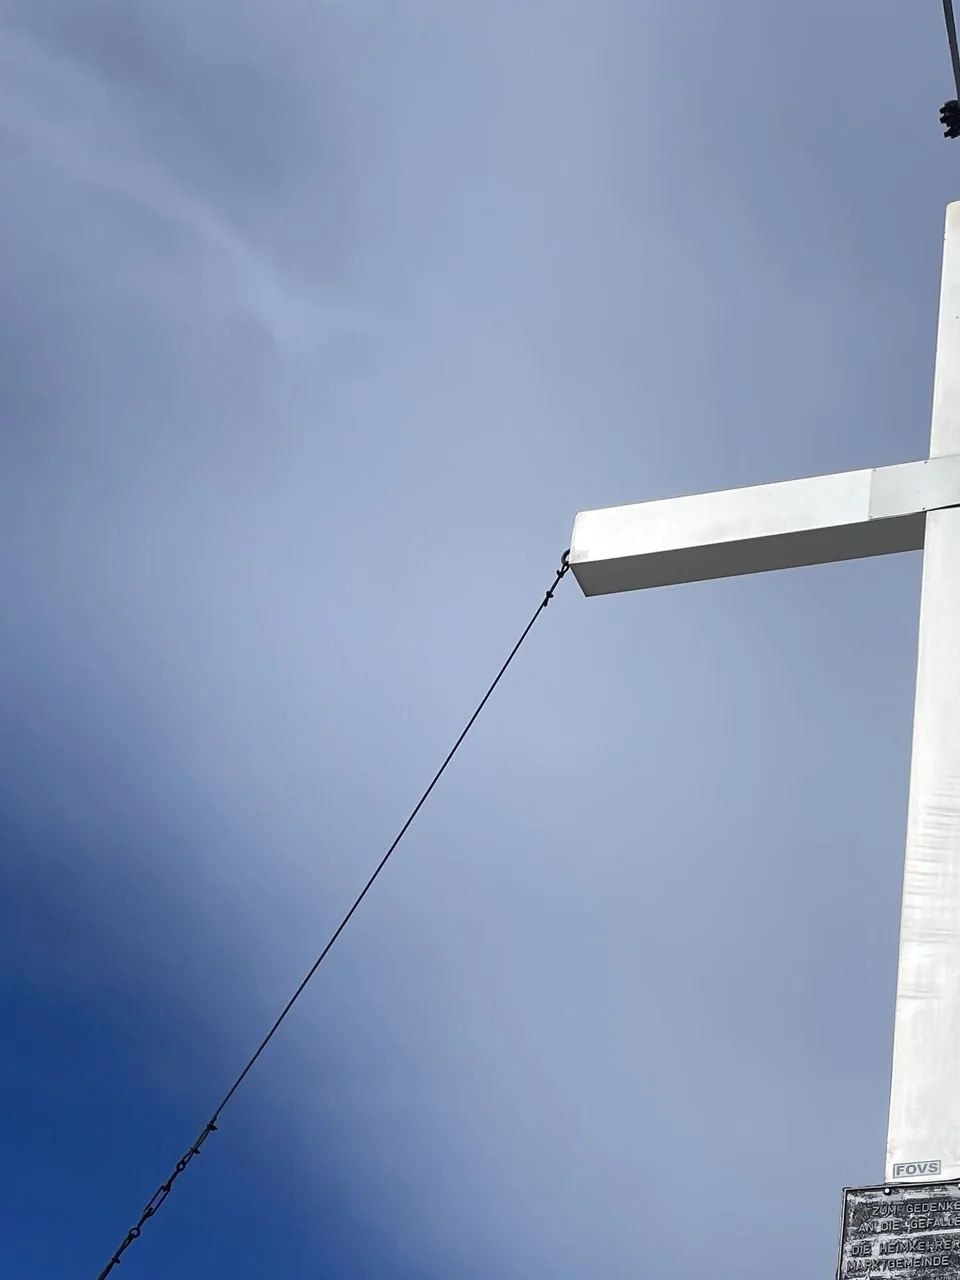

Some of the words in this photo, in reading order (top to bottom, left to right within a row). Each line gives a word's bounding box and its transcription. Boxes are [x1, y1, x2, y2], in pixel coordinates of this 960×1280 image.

[896, 1162, 938, 1176] FOVS
[872, 1205, 898, 1216] ZUM
[858, 1222, 874, 1233] AN
[881, 1220, 901, 1231] DIE
[851, 1244, 872, 1256] DIE
[879, 1239, 960, 1255] HEIMKEHRER
[846, 1255, 950, 1273] MARKTGEMEINDE
